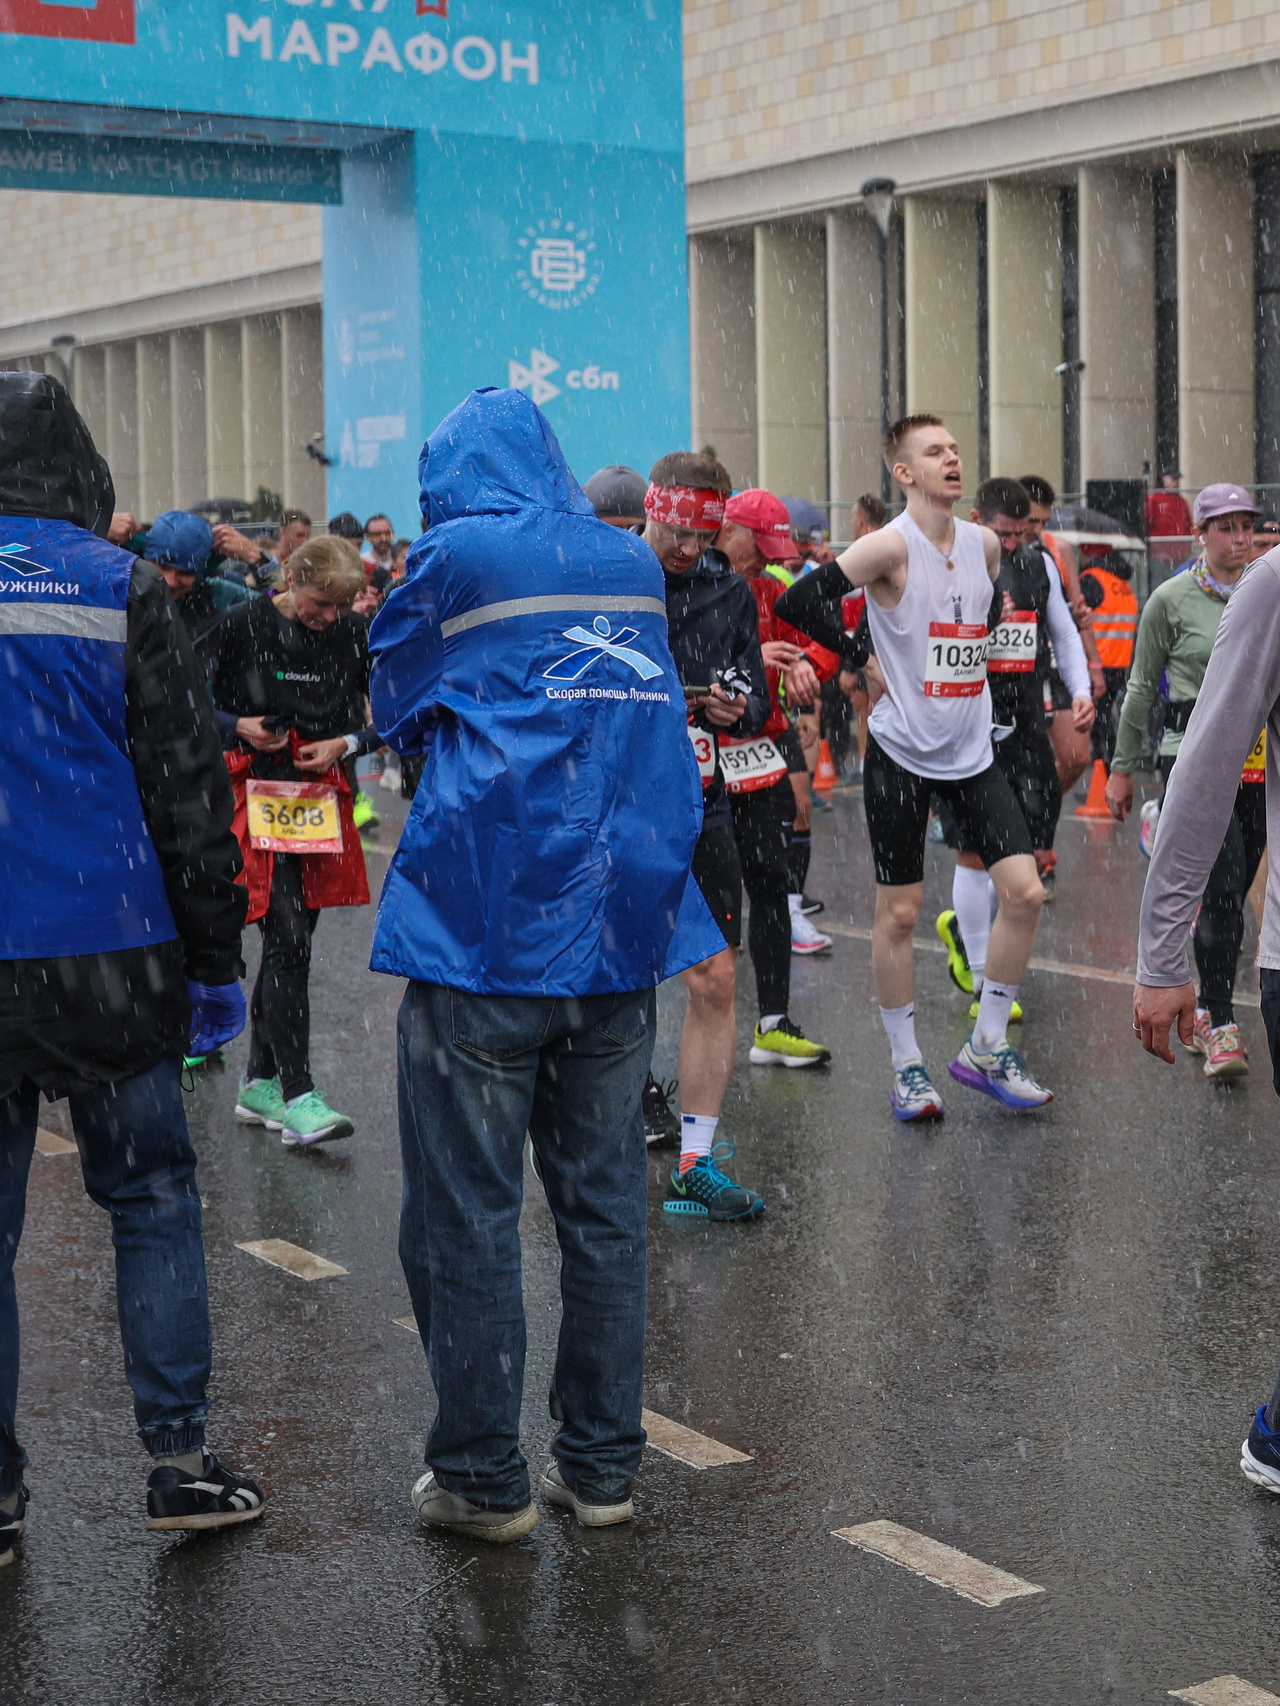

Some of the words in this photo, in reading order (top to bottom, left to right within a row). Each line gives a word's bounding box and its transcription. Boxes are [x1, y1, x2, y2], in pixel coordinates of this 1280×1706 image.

[226, 12, 539, 86] МАРАФОН
[285, 671, 320, 682] cloud.ru
[954, 668, 976, 677] ДАНИЛ
[545, 687, 587, 701] Скорая
[589, 688, 628, 700] помощь
[629, 688, 670, 702] Лужники
[932, 682, 942, 696] E
[695, 738, 711, 763] 3
[731, 781, 740, 793] D
[261, 803, 325, 827] 5608
[259, 836, 270, 848] D
